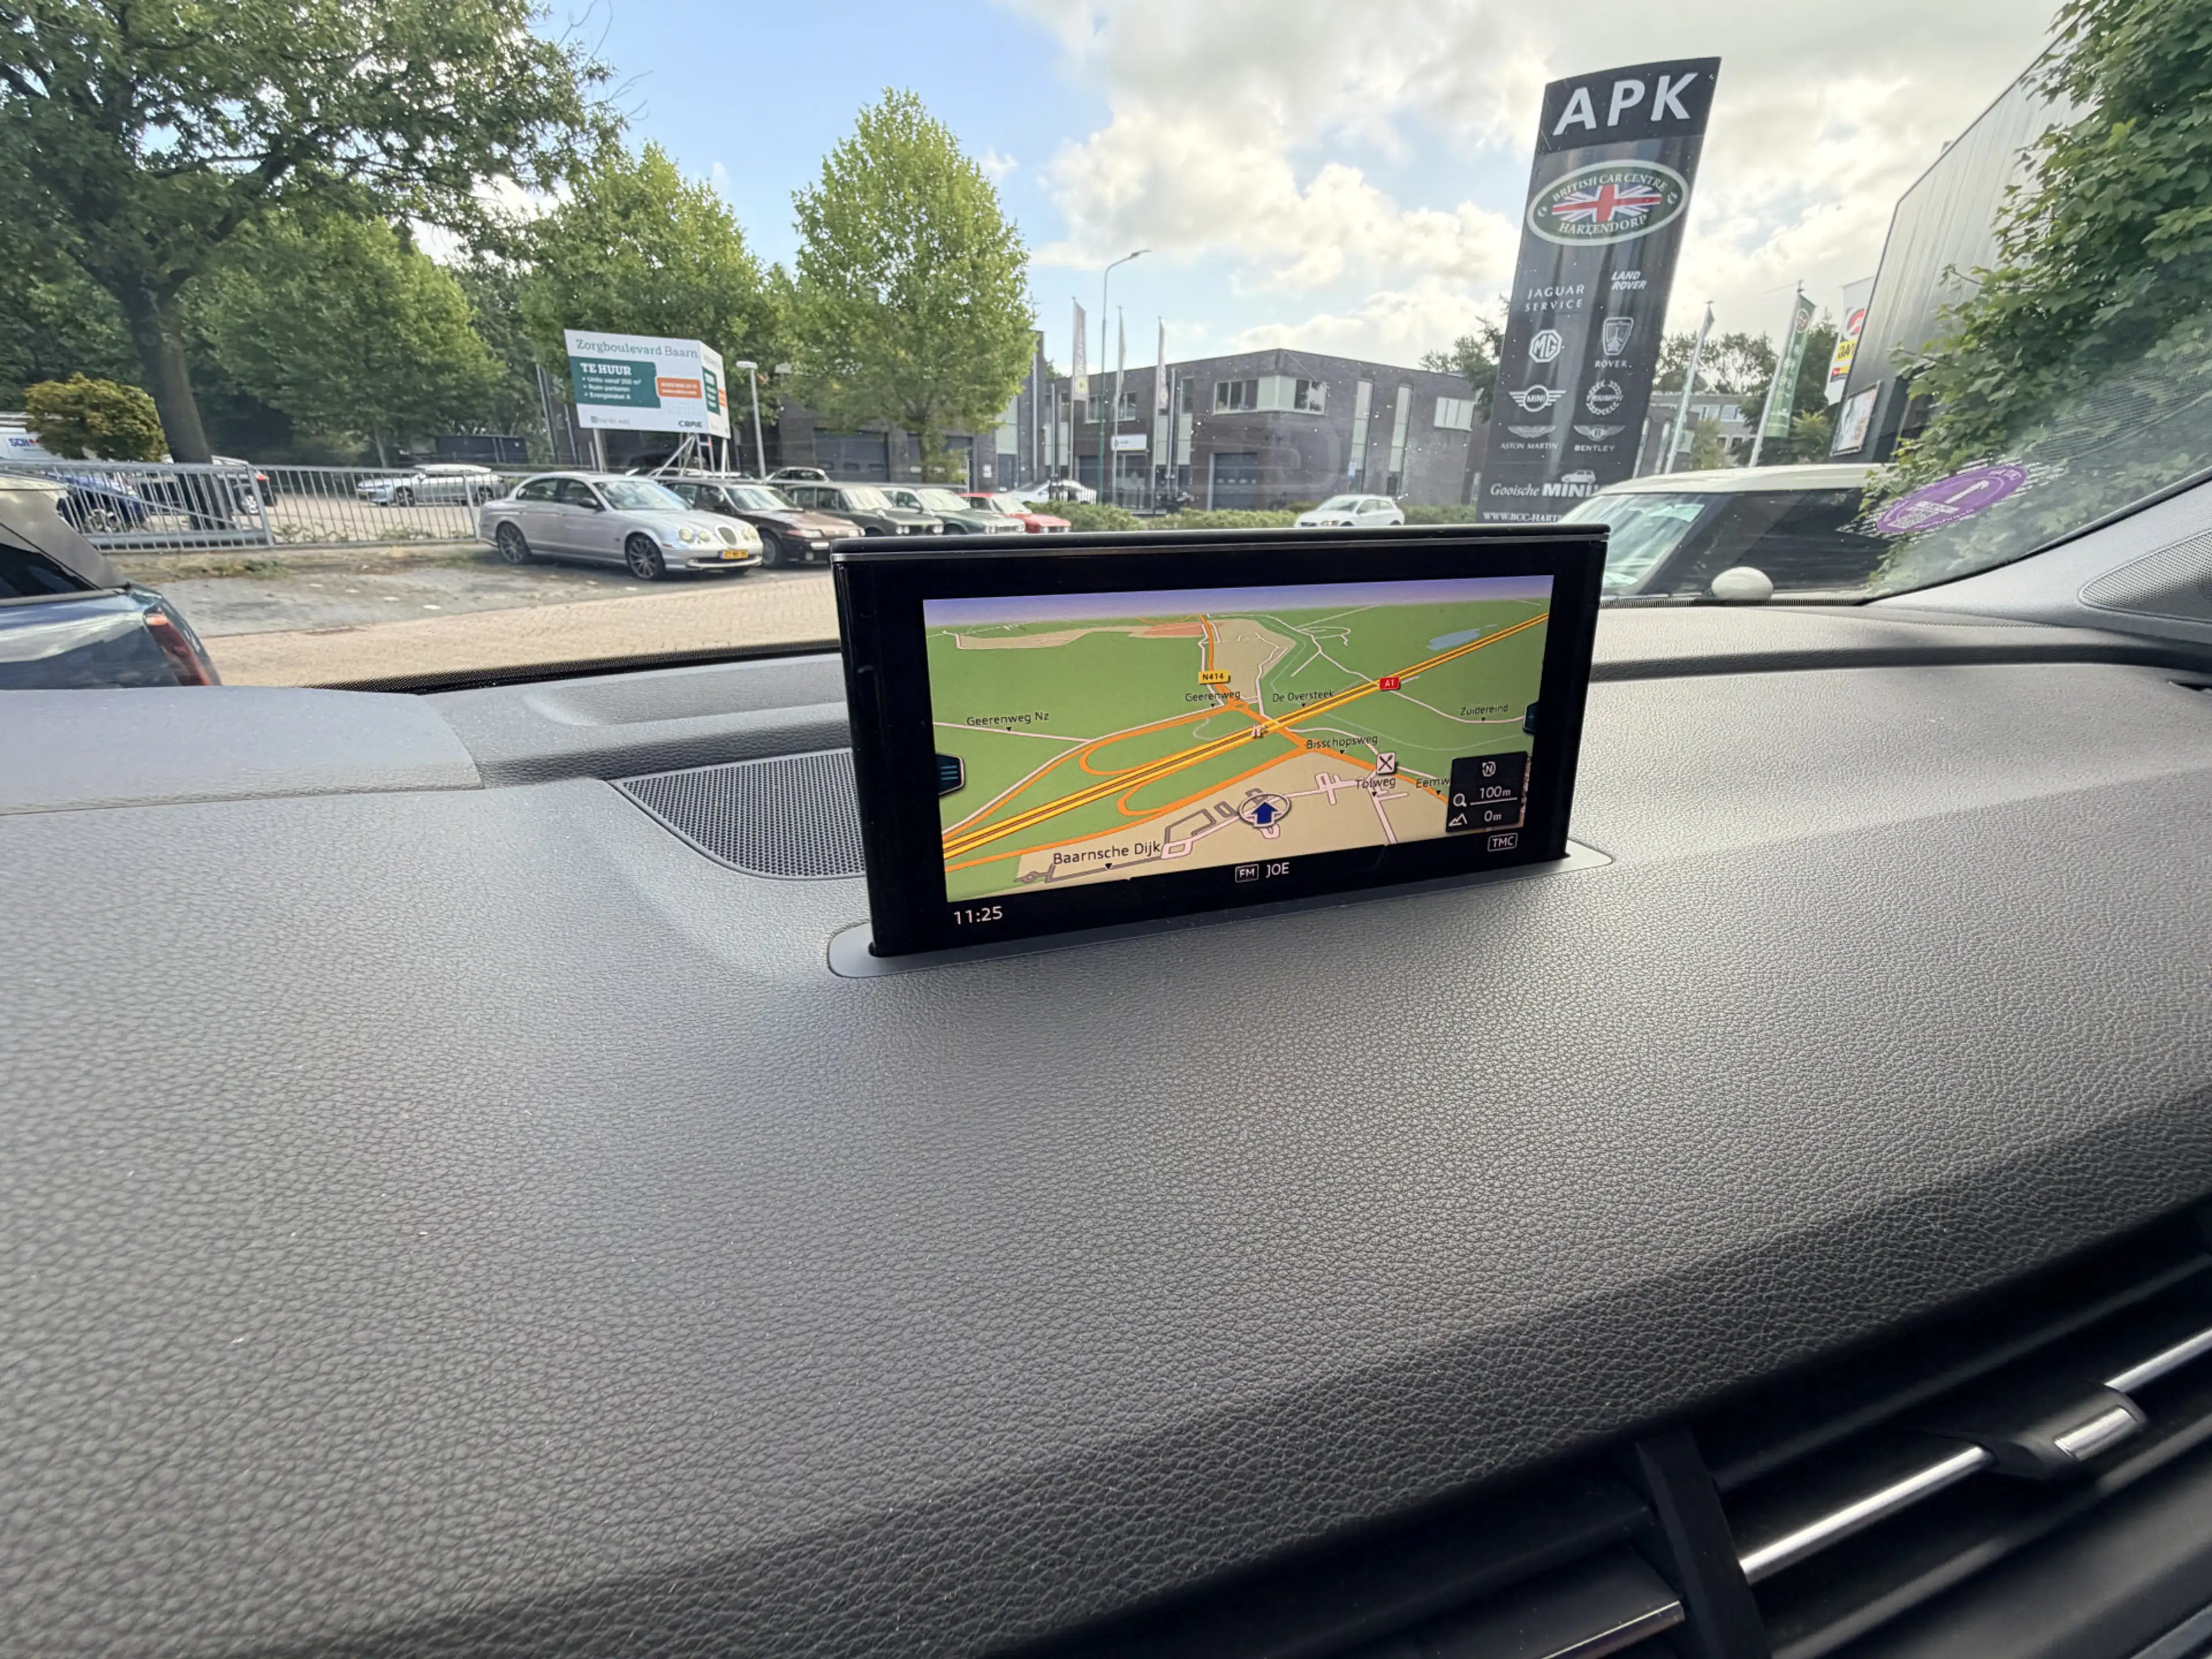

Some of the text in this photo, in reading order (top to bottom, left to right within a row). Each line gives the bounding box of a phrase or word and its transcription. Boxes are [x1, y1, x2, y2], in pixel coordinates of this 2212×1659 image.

[1553, 72, 1699, 136] APK
[1552, 173, 1668, 203] BRITISH CAR CENTRE
[1558, 215, 1647, 234] HARTENDORP
[1611, 270, 1641, 281] LAND
[1612, 280, 1647, 290] ROVER
[1528, 285, 1585, 300] JAGUAR
[1525, 298, 1584, 312] SERVICE
[575, 338, 698, 358] Zorgboulevard Baarn
[1533, 334, 1558, 358] MG
[579, 362, 632, 376] TE HUUR
[1527, 394, 1546, 403] MINI
[1501, 442, 1558, 450] ASTON MARTIN
[1490, 483, 1539, 497] Gooische
[1202, 672, 1224, 681] N414
[1384, 679, 1395, 688] A1
[1185, 689, 1241, 703] Geerenweg
[1272, 690, 1334, 702] De Oversteek
[1460, 703, 1509, 717] Zuidereind
[967, 711, 1050, 728] Geerenweg Nz
[1306, 735, 1378, 750] Bisschopsweg
[1355, 777, 1396, 790] Tolweg
[1479, 785, 1512, 799] 100m
[1484, 810, 1502, 822] 0m
[1492, 836, 1514, 848] TMC
[1054, 840, 1161, 865] Baarnsche Dijk
[1239, 862, 1290, 878] FM JOE
[953, 906, 1003, 925] 11:25
